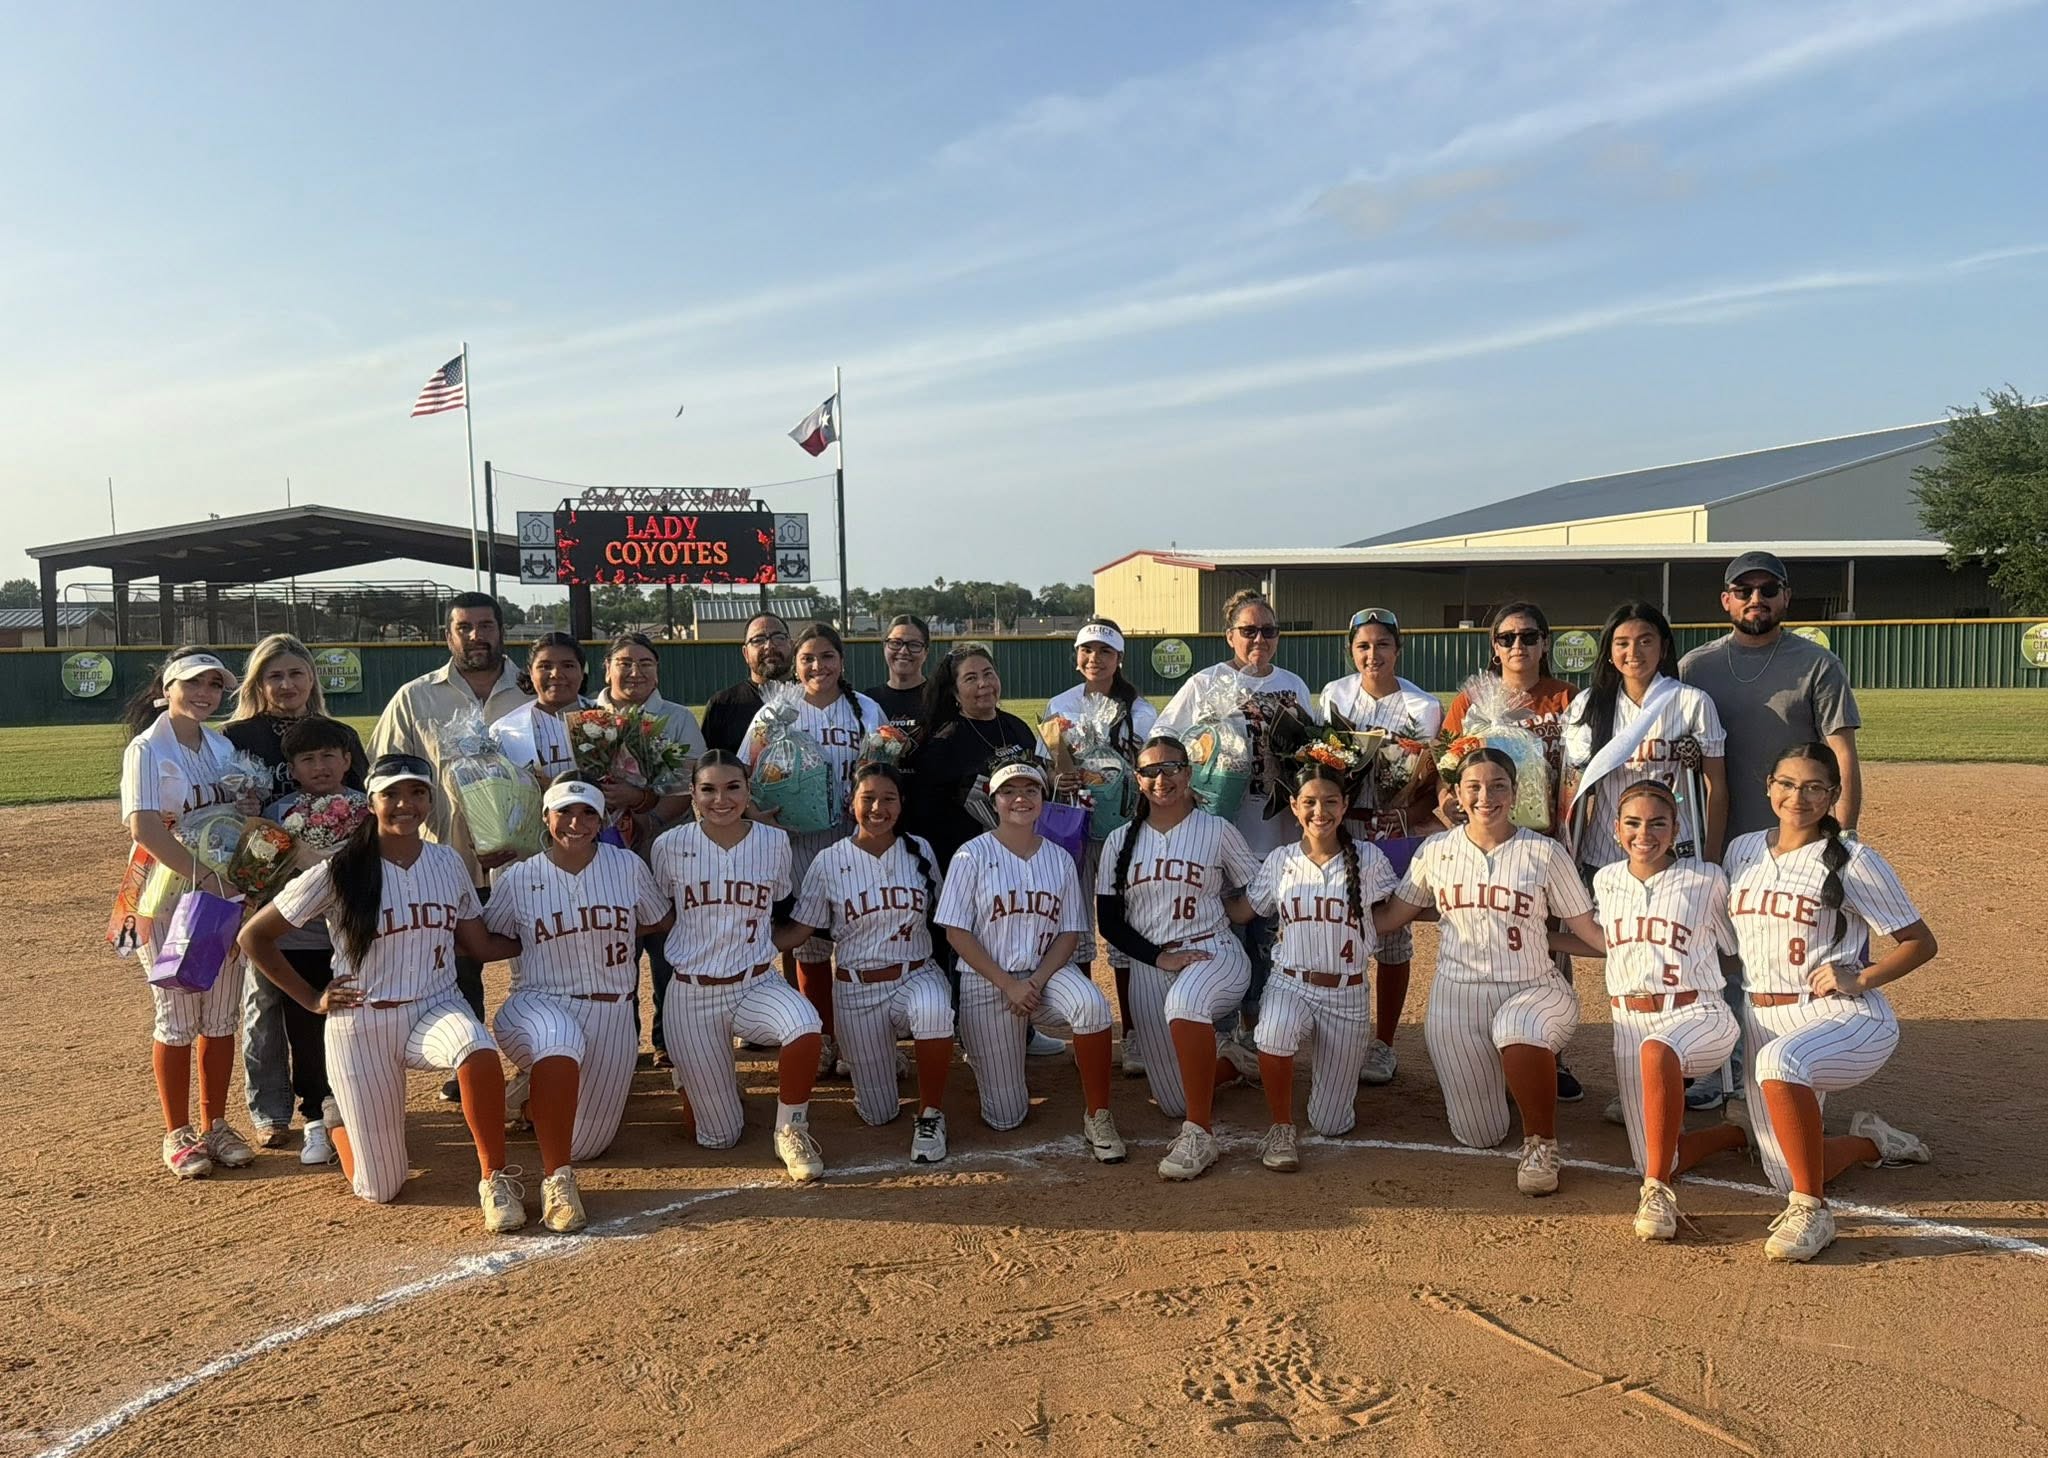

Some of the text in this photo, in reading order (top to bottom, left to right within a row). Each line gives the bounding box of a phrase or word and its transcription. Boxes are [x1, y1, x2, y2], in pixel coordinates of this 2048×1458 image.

[626, 516, 699, 540] LADY
[605, 541, 728, 565] COYOTES
[1087, 626, 1114, 638] ALICE
[1566, 657, 1585, 668] #16
[73, 671, 103, 681] KHLOE
[80, 681, 97, 693] #8
[330, 676, 346, 688] #9
[889, 719, 916, 727] OYOTE
[1002, 766, 1033, 776] ALICE
[1127, 858, 1205, 889] LICE
[684, 880, 771, 910] ALICE
[844, 886, 925, 925] ALICE
[990, 889, 1062, 925] ALICE
[1440, 883, 1534, 918] ALICE
[1172, 896, 1197, 921] 16
[535, 904, 631, 945] ALICE
[745, 919, 758, 944] 7
[1507, 926, 1523, 951] 9
[605, 942, 628, 967] 12
[1340, 939, 1354, 964] 4
[1789, 937, 1806, 966] 8
[1663, 963, 1680, 987] 5
